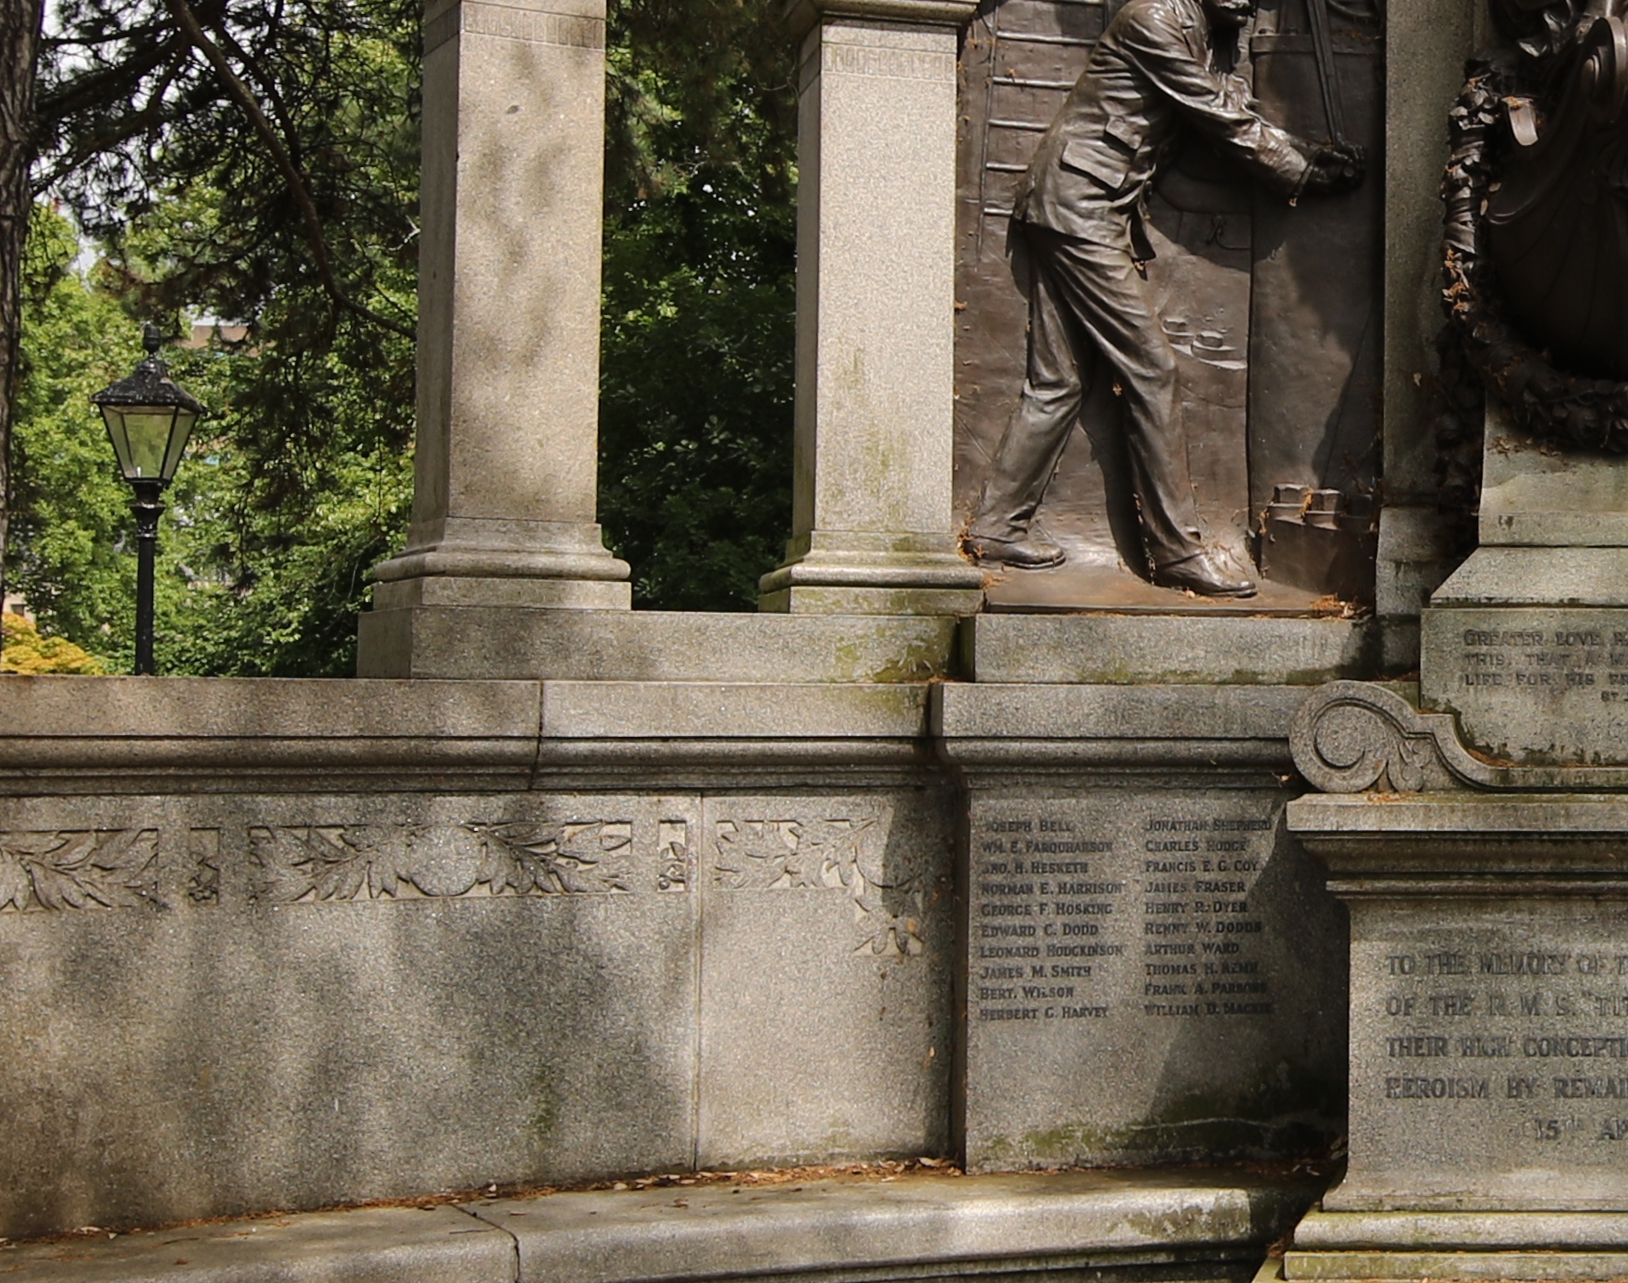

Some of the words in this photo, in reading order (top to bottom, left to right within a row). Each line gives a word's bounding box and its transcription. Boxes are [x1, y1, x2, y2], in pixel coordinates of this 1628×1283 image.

[1463, 629, 1544, 647] GREATER
[1556, 629, 1600, 647] LOVE
[1527, 651, 1571, 669] THAT
[1465, 673, 1502, 687] LIFE
[1517, 673, 1551, 687] FOR
[1040, 820, 1073, 833] BELL
[1145, 840, 1199, 853] CHARLES
[1031, 861, 1089, 874] HESKETH
[1145, 861, 1196, 873] FRANCIS
[981, 883, 1034, 895] NORMAN
[1040, 883, 1054, 895] E.
[1195, 881, 1246, 894] FRASER
[981, 903, 1032, 916] GEORGE
[1056, 903, 1113, 916] HOSKING
[1213, 901, 1248, 914] DYER
[981, 924, 1036, 937] EDWARD
[1044, 924, 1057, 937] C.
[1063, 924, 1099, 937] DODD
[980, 944, 1040, 958] LEONARD
[1144, 942, 1195, 955] ARTHUR
[1201, 942, 1240, 955] WARD
[1145, 962, 1198, 975] THOMAS
[1387, 953, 1415, 976] TO
[1426, 953, 1467, 976] THE
[1479, 953, 1569, 976] MEMORY
[1577, 953, 1606, 976] OF
[980, 965, 1024, 979] JAMES
[1032, 965, 1048, 979] M.
[1385, 995, 1415, 1017] OF
[1429, 995, 1473, 1017] THE
[1062, 1007, 1109, 1020] HARVEY
[1386, 1036, 1449, 1058] THEIR
[1459, 1036, 1512, 1058] HIGH
[1385, 1076, 1490, 1100] HEROISM
[1506, 1076, 1539, 1100] BY
